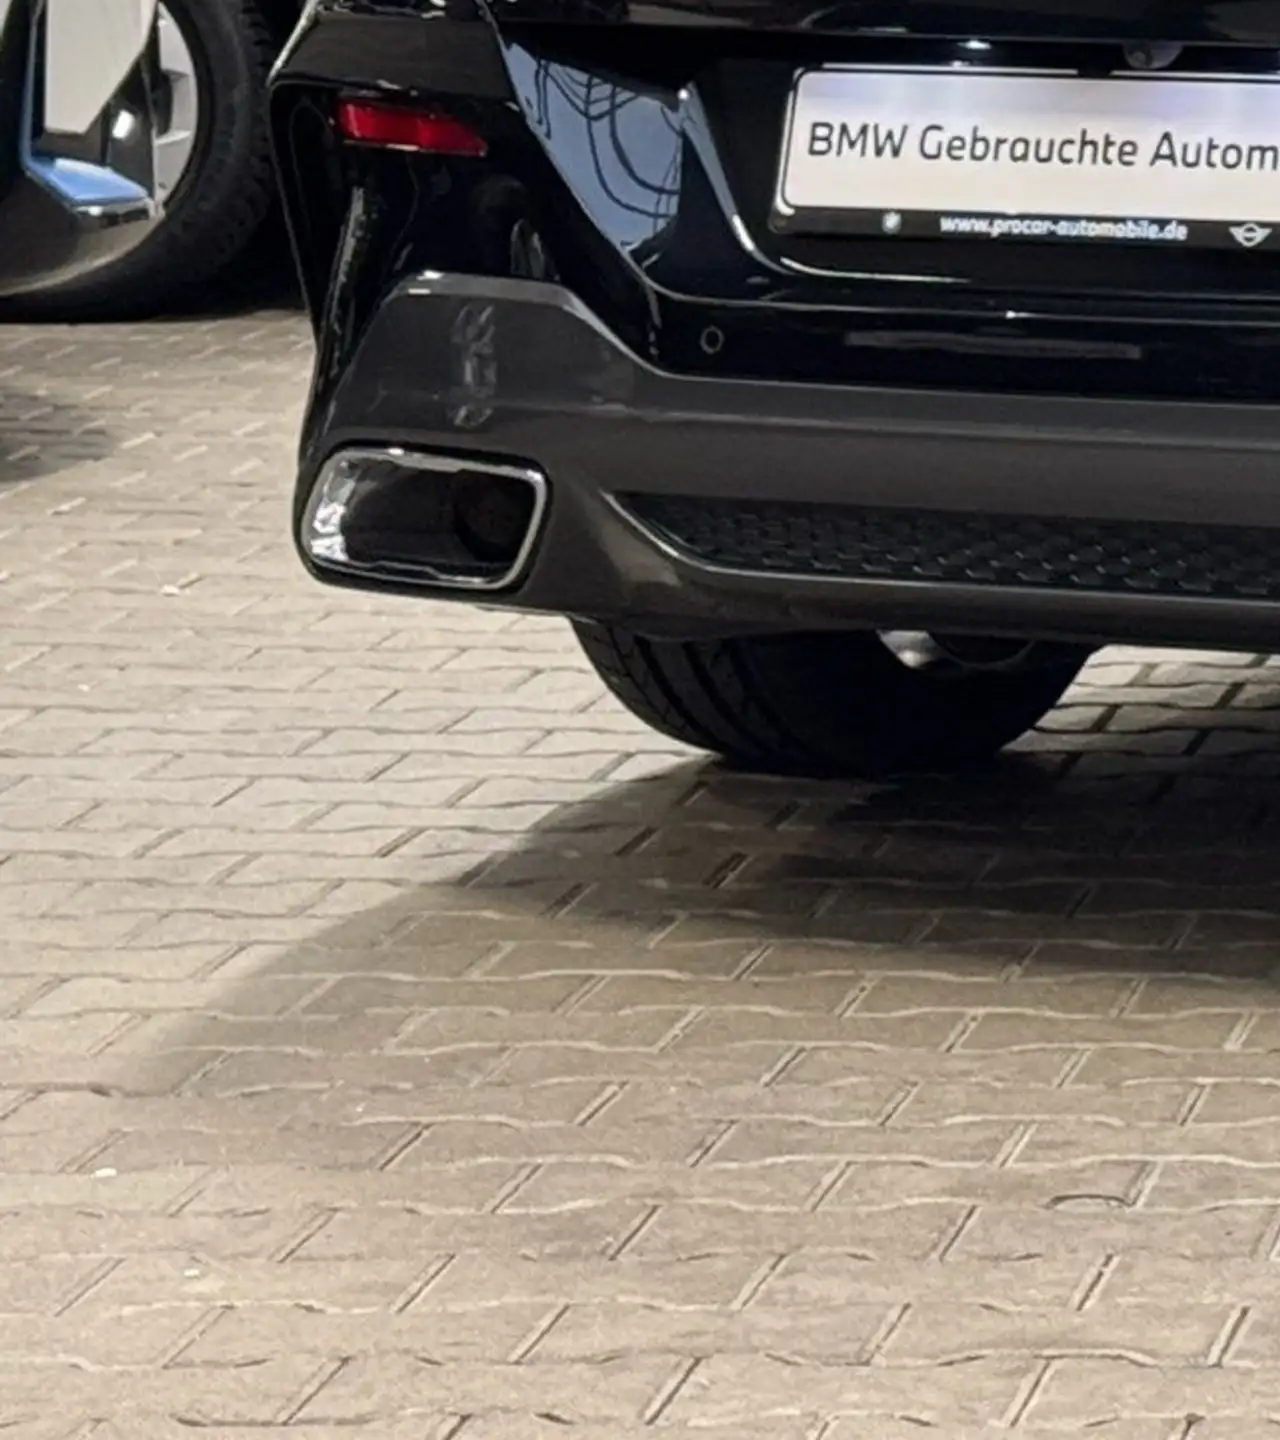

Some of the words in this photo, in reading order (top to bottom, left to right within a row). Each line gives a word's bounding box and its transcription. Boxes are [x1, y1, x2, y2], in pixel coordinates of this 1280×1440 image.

[807, 121, 909, 159] BMW
[918, 124, 1139, 167] Gebrauchte
[940, 216, 1189, 242] www.procar-automobile.de
